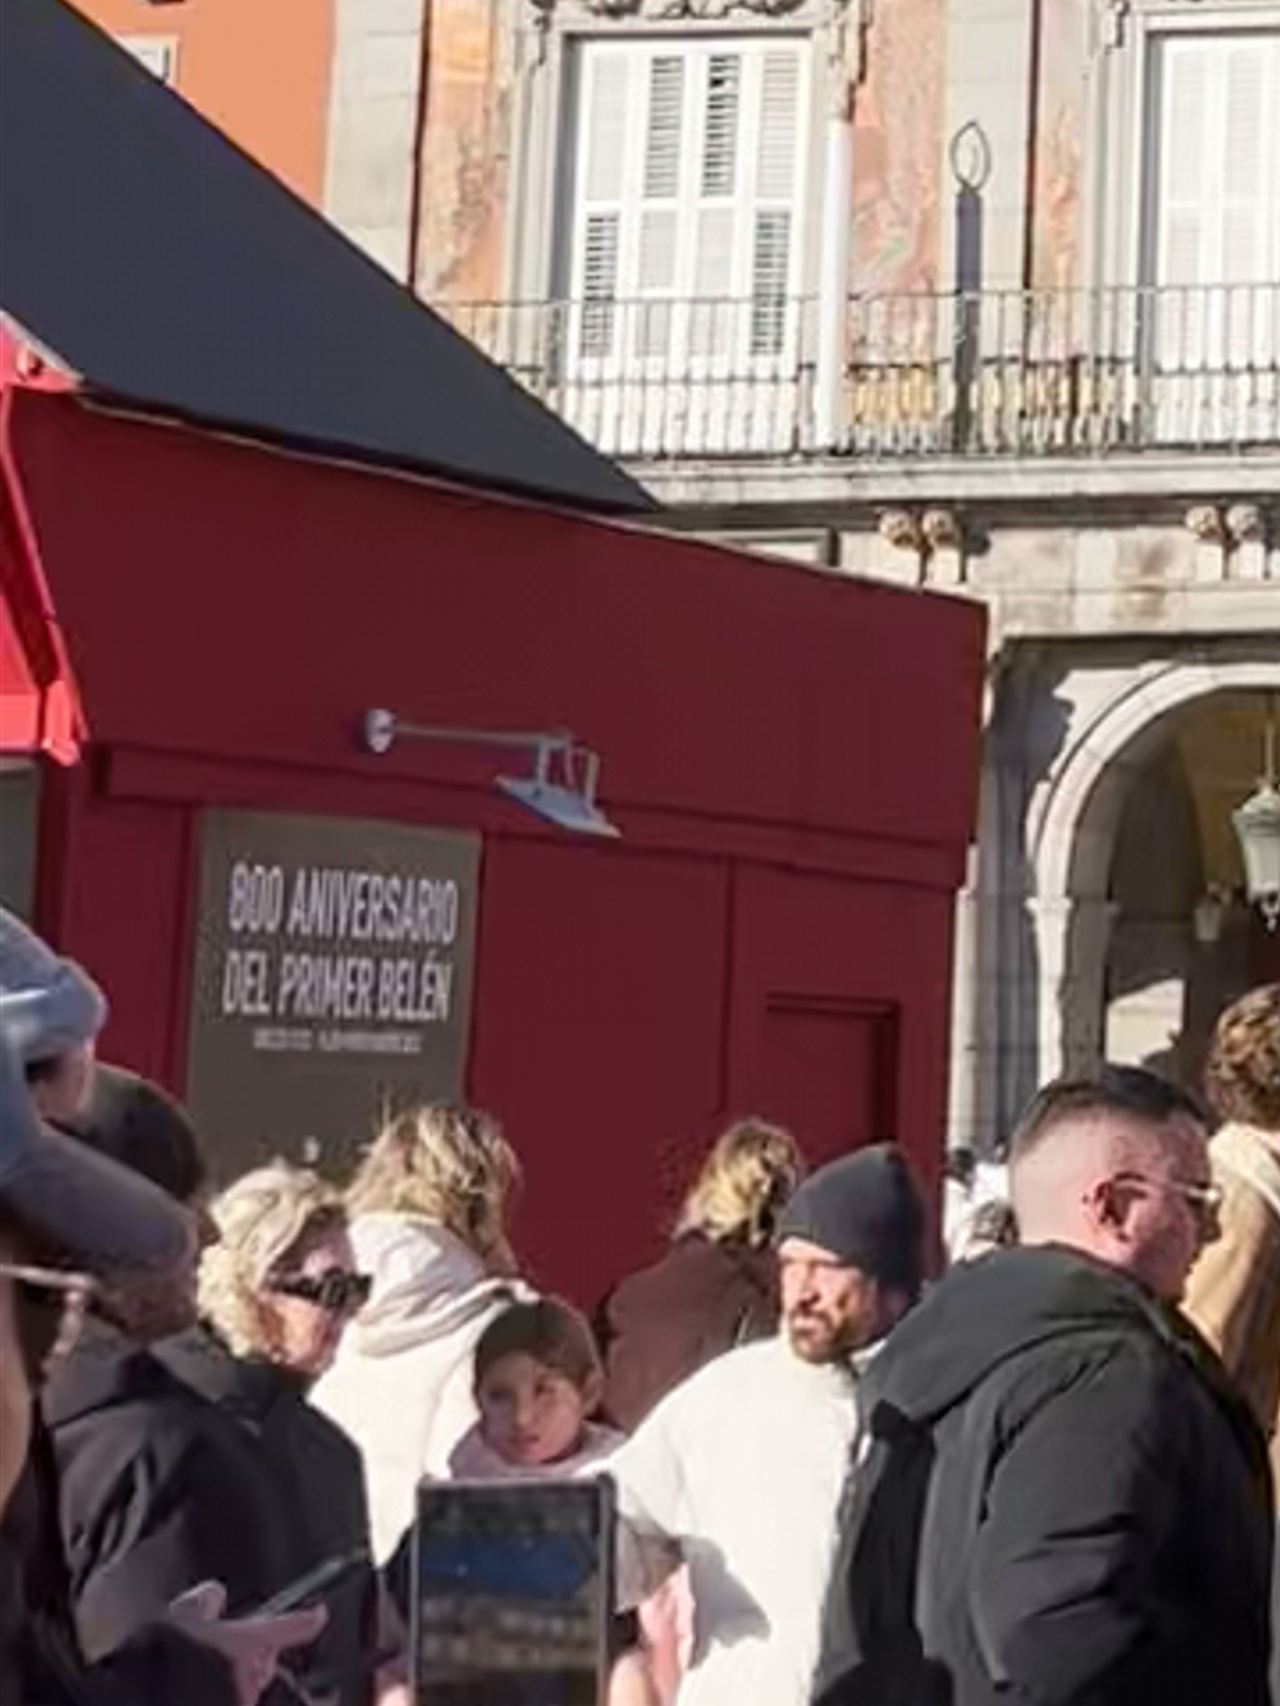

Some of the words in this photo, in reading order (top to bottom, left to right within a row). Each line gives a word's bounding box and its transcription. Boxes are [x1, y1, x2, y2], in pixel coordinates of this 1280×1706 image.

[228, 863, 283, 933] 800
[287, 869, 459, 943] ANIVERSARIO
[223, 950, 271, 1017] DEL
[277, 956, 373, 1019] PRIMER
[377, 949, 454, 1021] BELÉN
